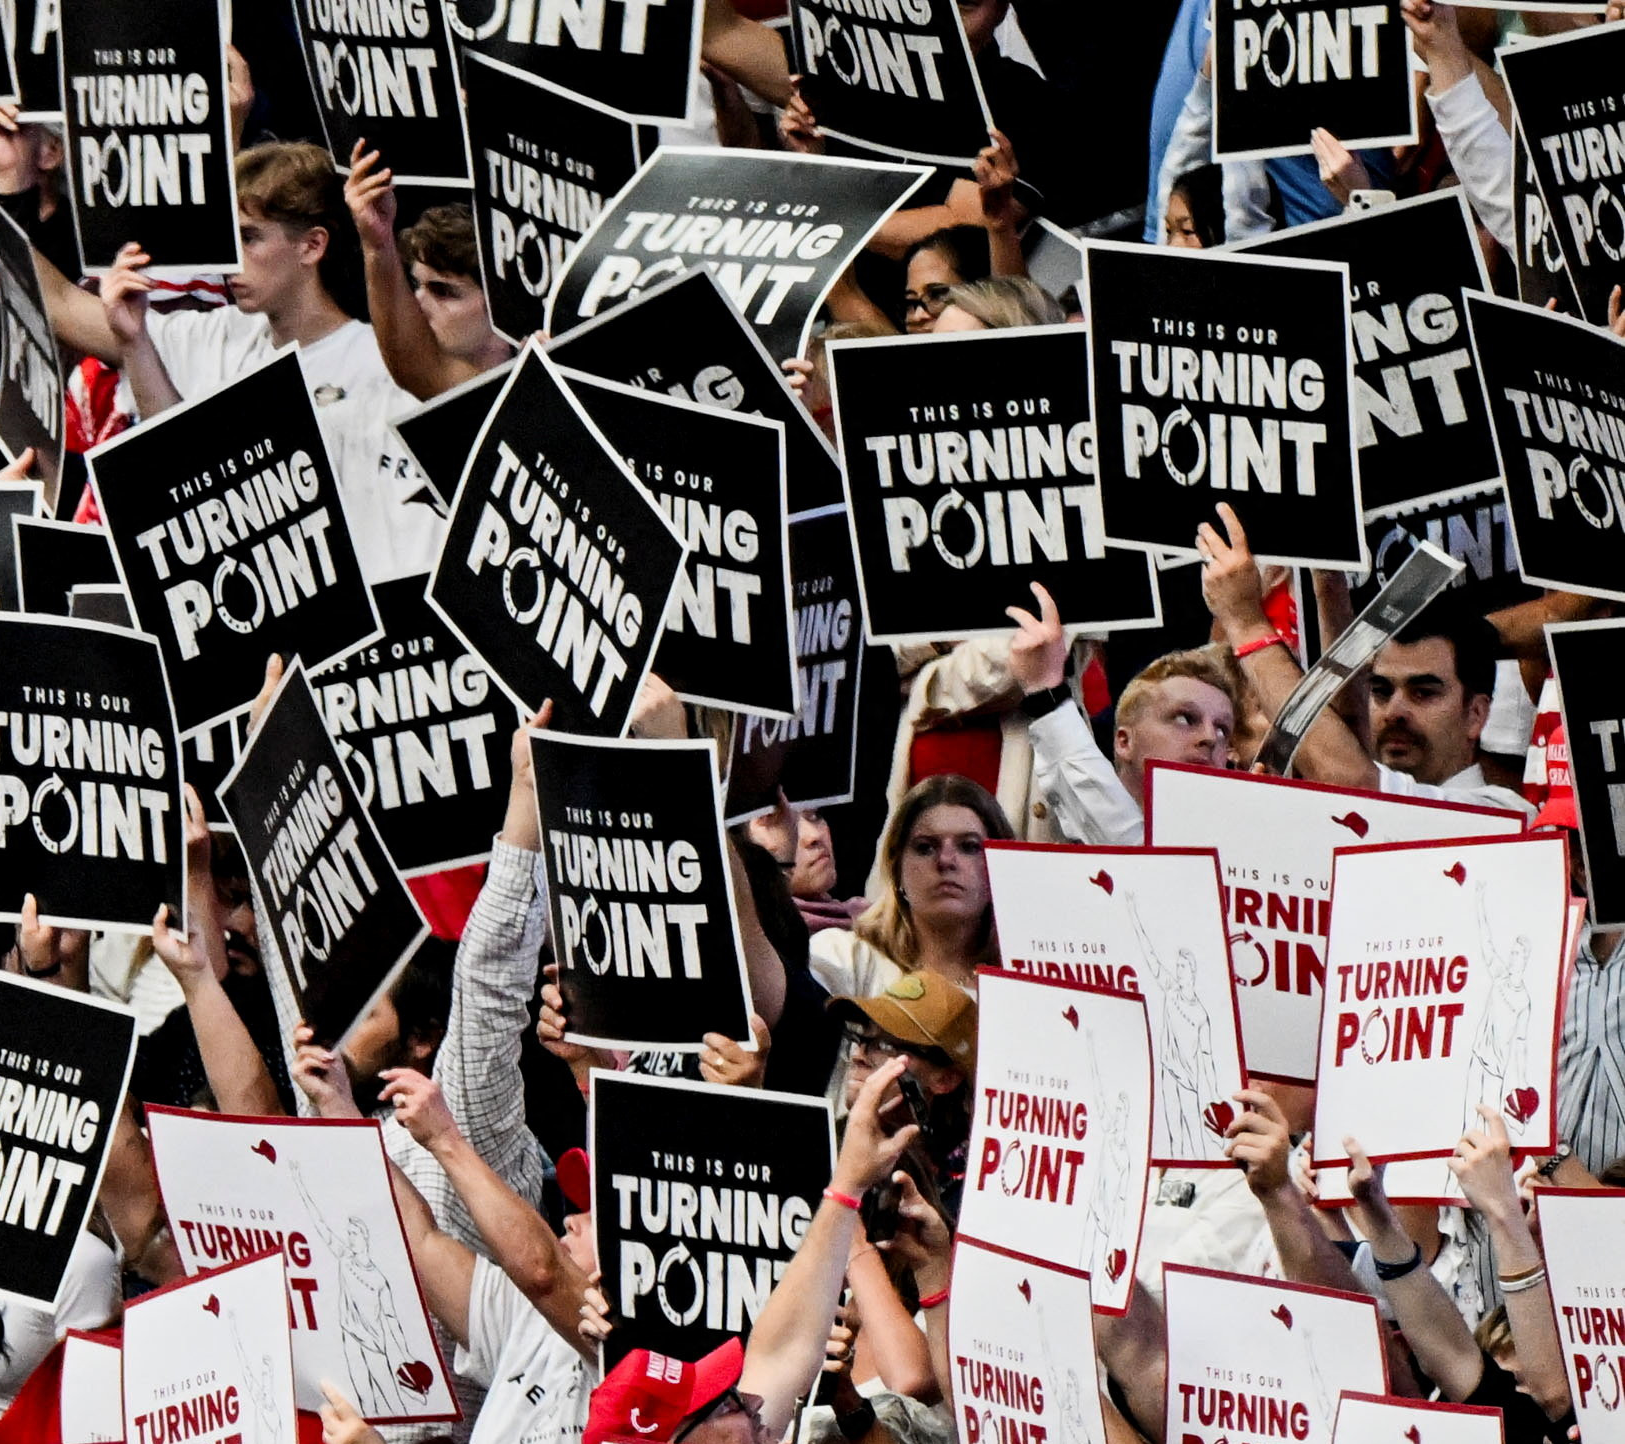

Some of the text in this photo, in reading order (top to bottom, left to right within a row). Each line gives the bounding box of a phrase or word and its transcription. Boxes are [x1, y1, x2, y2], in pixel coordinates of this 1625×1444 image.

[1152, 318, 1277, 345] THIS IS OUR
[1111, 341, 1324, 411] TURNING
